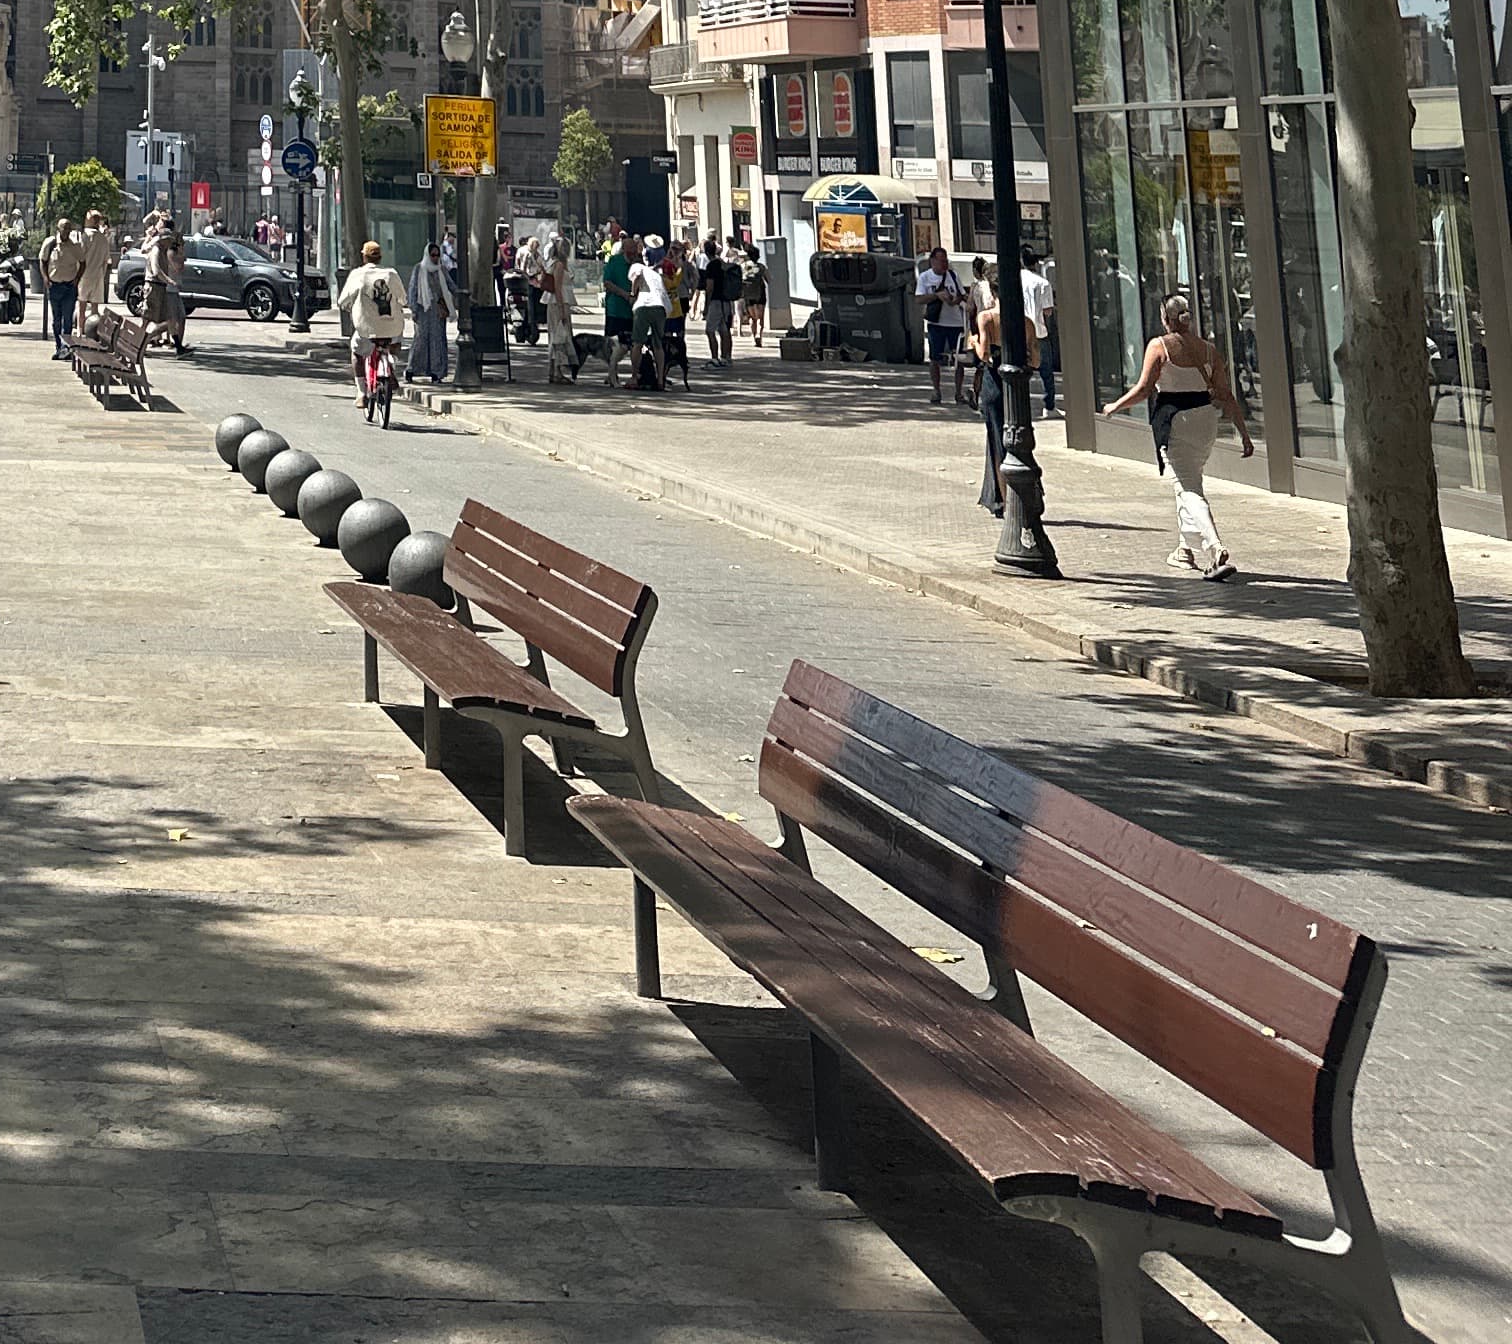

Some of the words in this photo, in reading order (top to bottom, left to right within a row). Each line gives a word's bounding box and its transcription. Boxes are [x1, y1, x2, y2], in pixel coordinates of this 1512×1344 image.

[444, 102, 479, 113] PERILL
[432, 111, 476, 123] SORTIDA
[477, 114, 491, 124] DE
[439, 123, 485, 134] CAMIONS
[441, 139, 485, 150] PELIGRO
[436, 149, 474, 160] SALIDA
[820, 157, 841, 172] BURGER
[842, 158, 857, 173] KING
